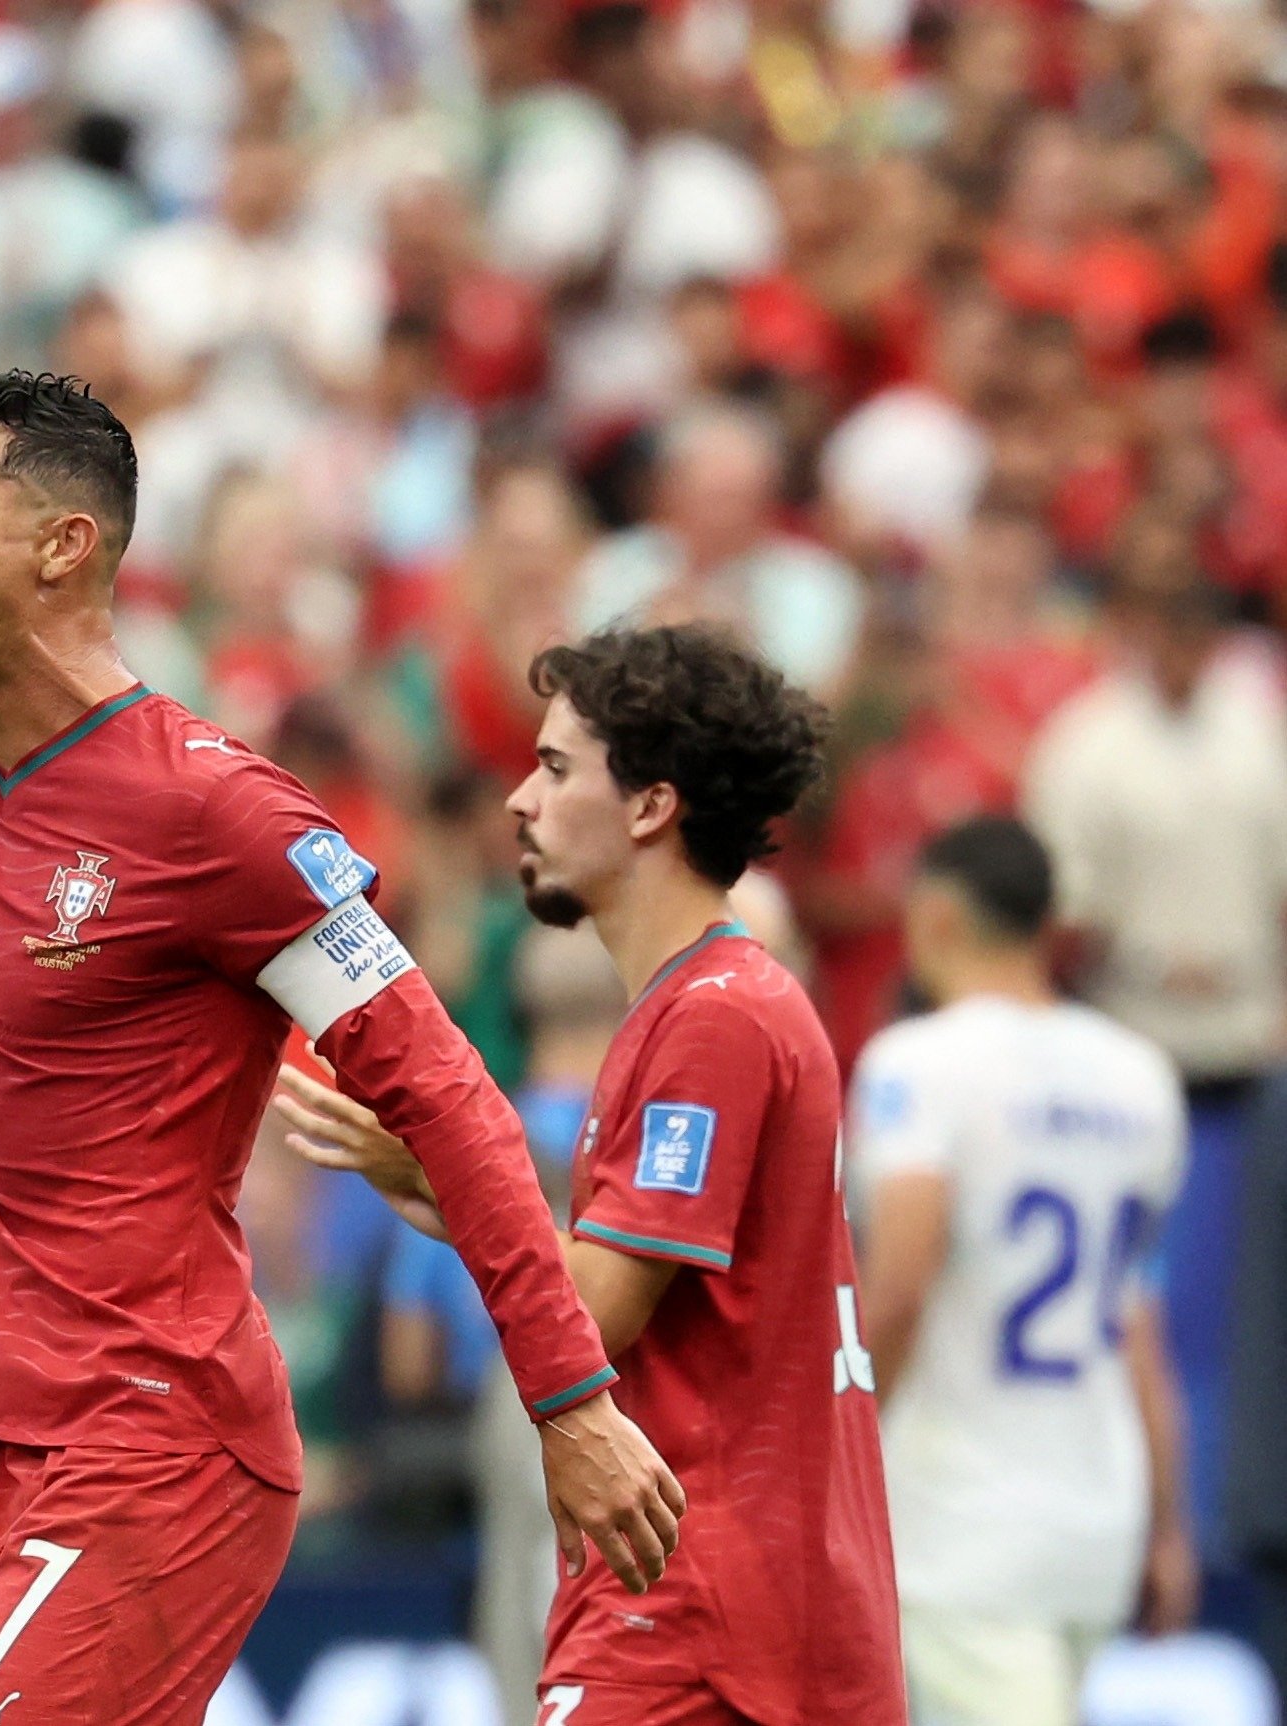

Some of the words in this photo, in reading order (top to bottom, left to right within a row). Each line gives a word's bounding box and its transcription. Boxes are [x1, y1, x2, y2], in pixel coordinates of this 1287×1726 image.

[333, 865, 364, 897] PEACE
[34, 956, 73, 971] HOUSTON
[64, 951, 86, 963] 2026
[342, 958, 373, 982] the
